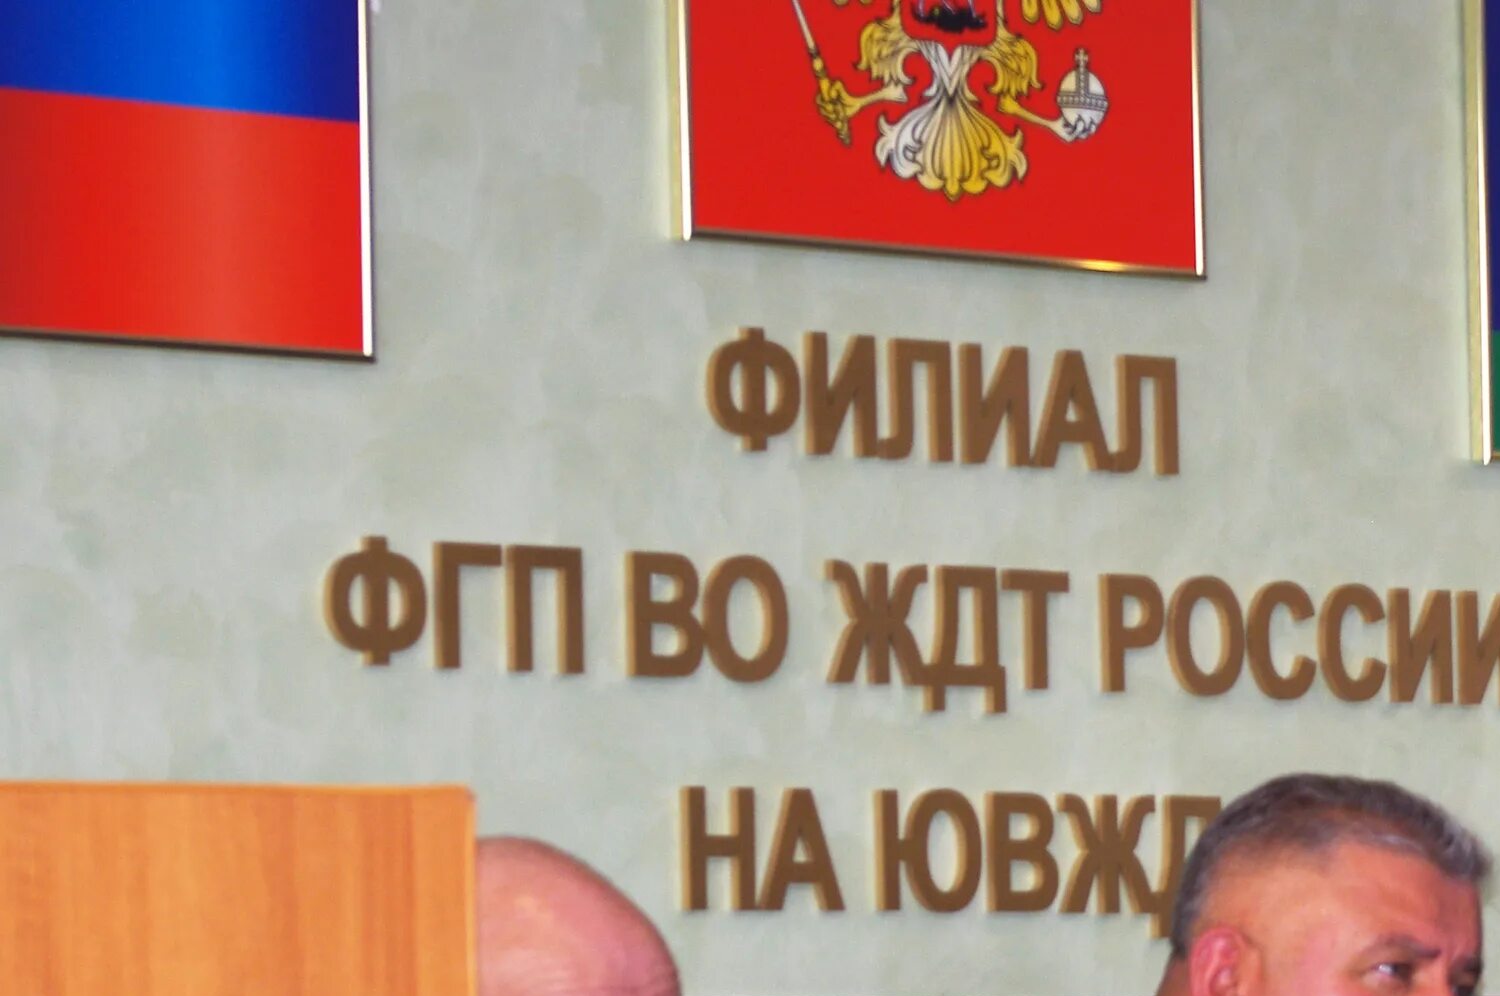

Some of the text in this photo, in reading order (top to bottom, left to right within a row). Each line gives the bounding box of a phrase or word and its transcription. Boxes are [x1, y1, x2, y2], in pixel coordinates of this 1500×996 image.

[706, 326, 1180, 476] ФИЛИАЛ
[323, 535, 585, 675] ФГП
[624, 550, 789, 683] ВО
[824, 558, 1070, 713] ЖДТ
[679, 785, 846, 911] НА
